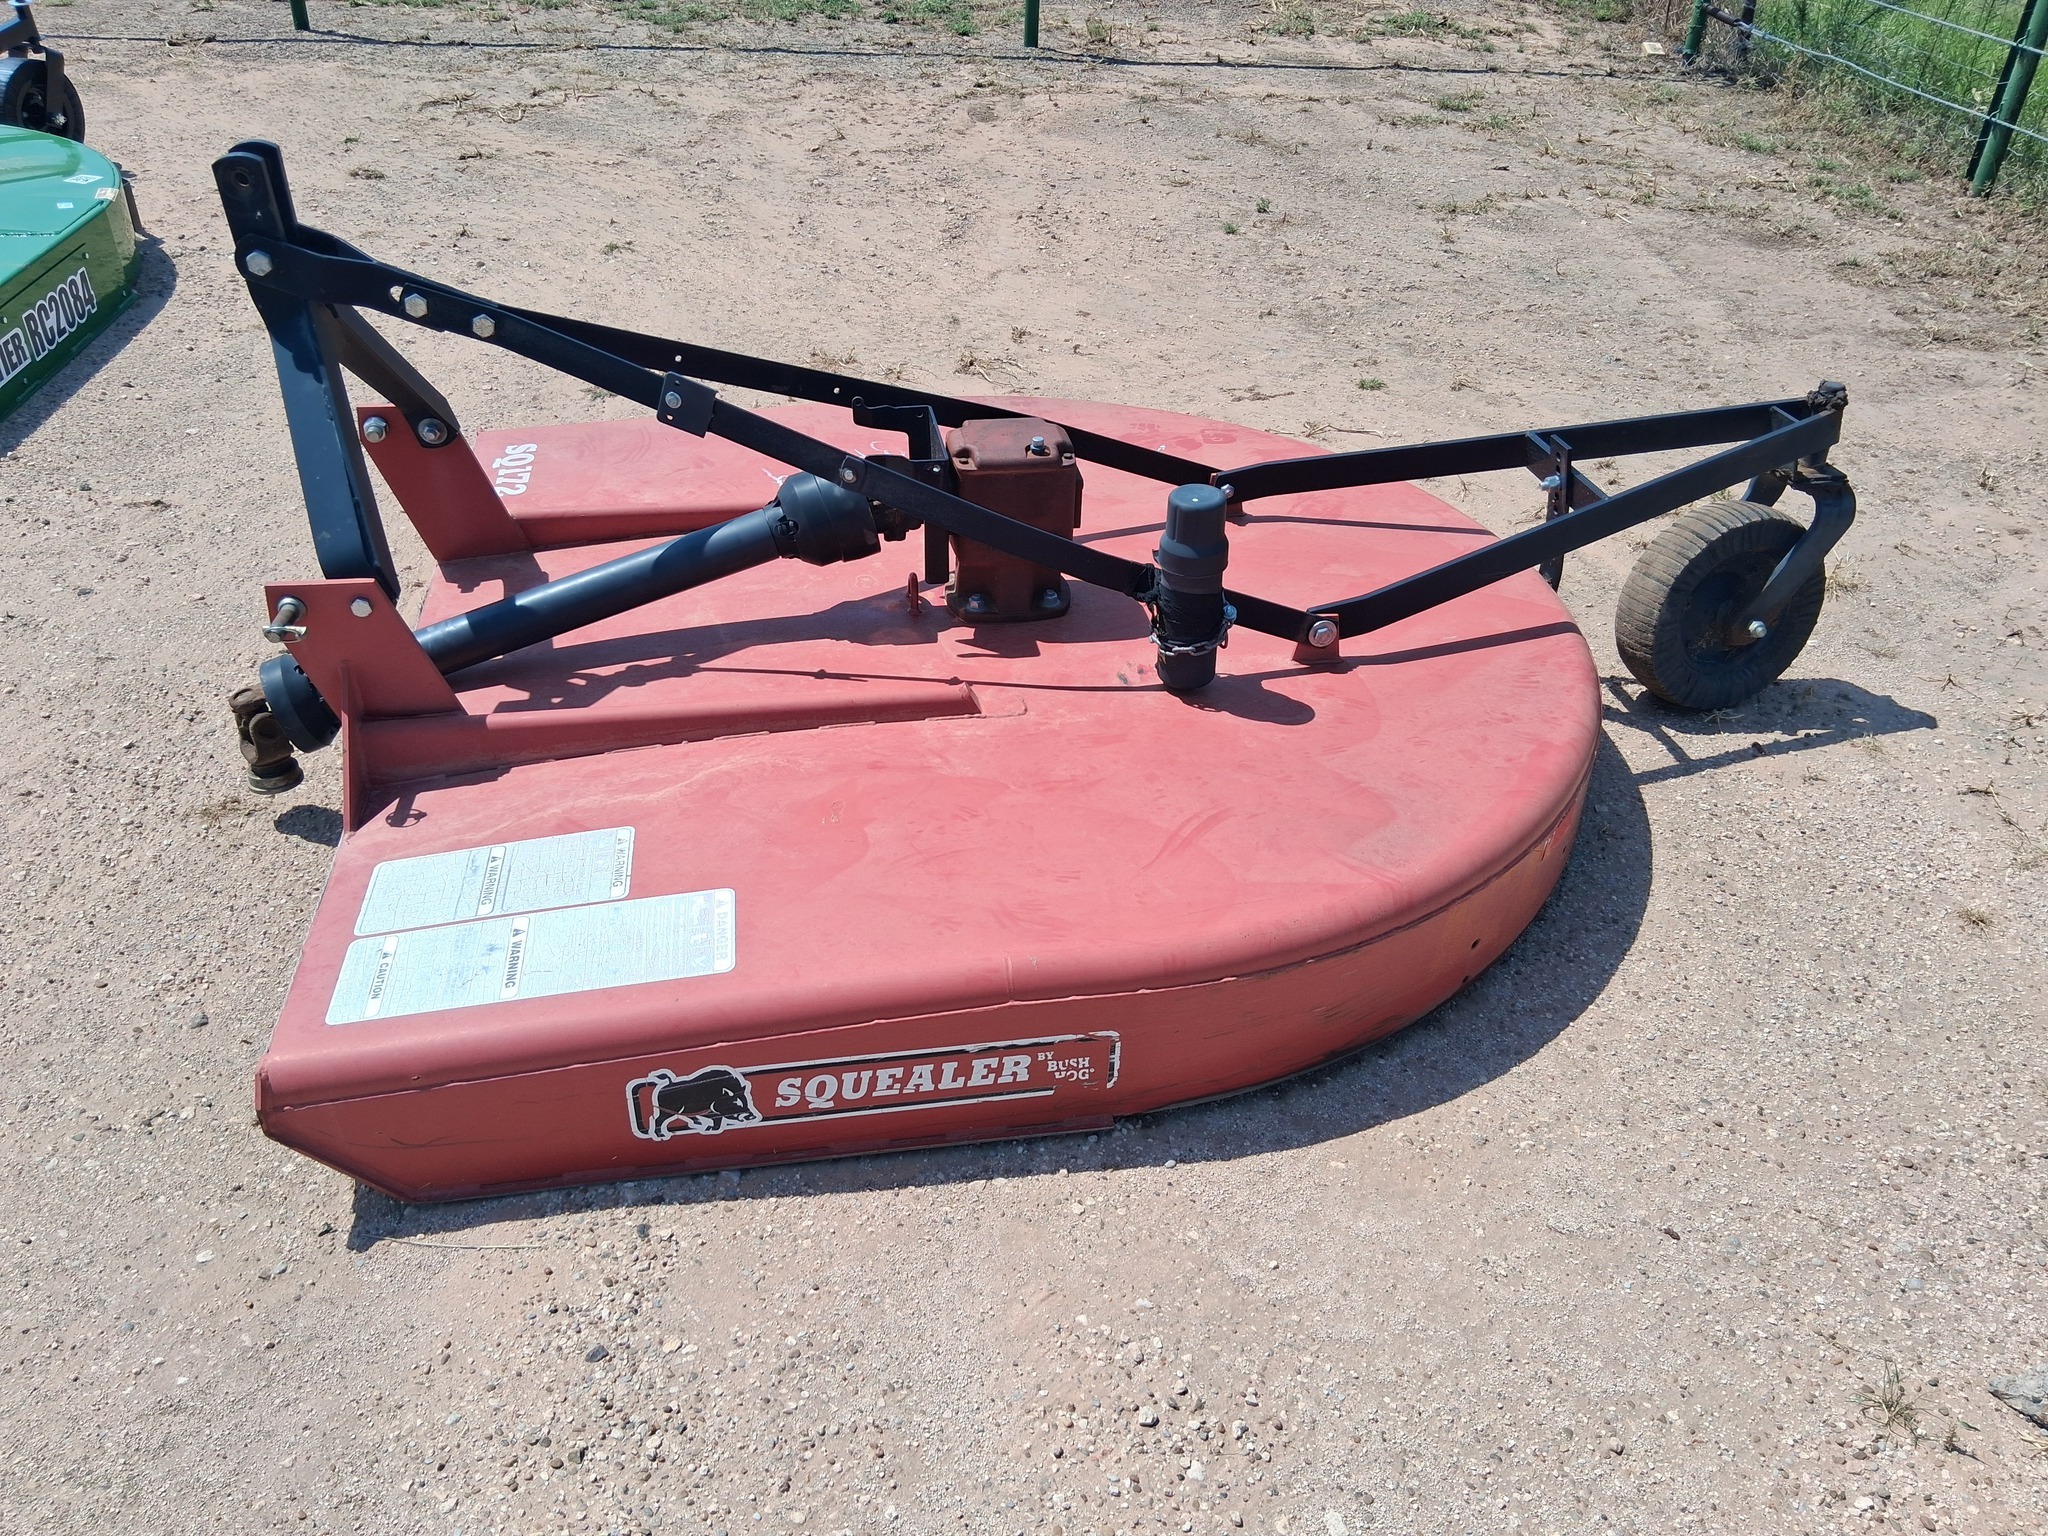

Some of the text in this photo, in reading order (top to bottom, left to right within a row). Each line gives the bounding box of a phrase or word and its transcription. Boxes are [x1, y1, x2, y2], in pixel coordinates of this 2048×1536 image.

[22, 268, 97, 361] RC2084
[492, 443, 538, 497] SQ172
[480, 864, 500, 906] WARNING
[612, 847, 628, 888] WARNING
[370, 962, 389, 1000] CAUTION
[504, 939, 523, 989] WARNING
[775, 1051, 1054, 1110] SQUEALER BY
[1047, 1056, 1090, 1072] BUSH
